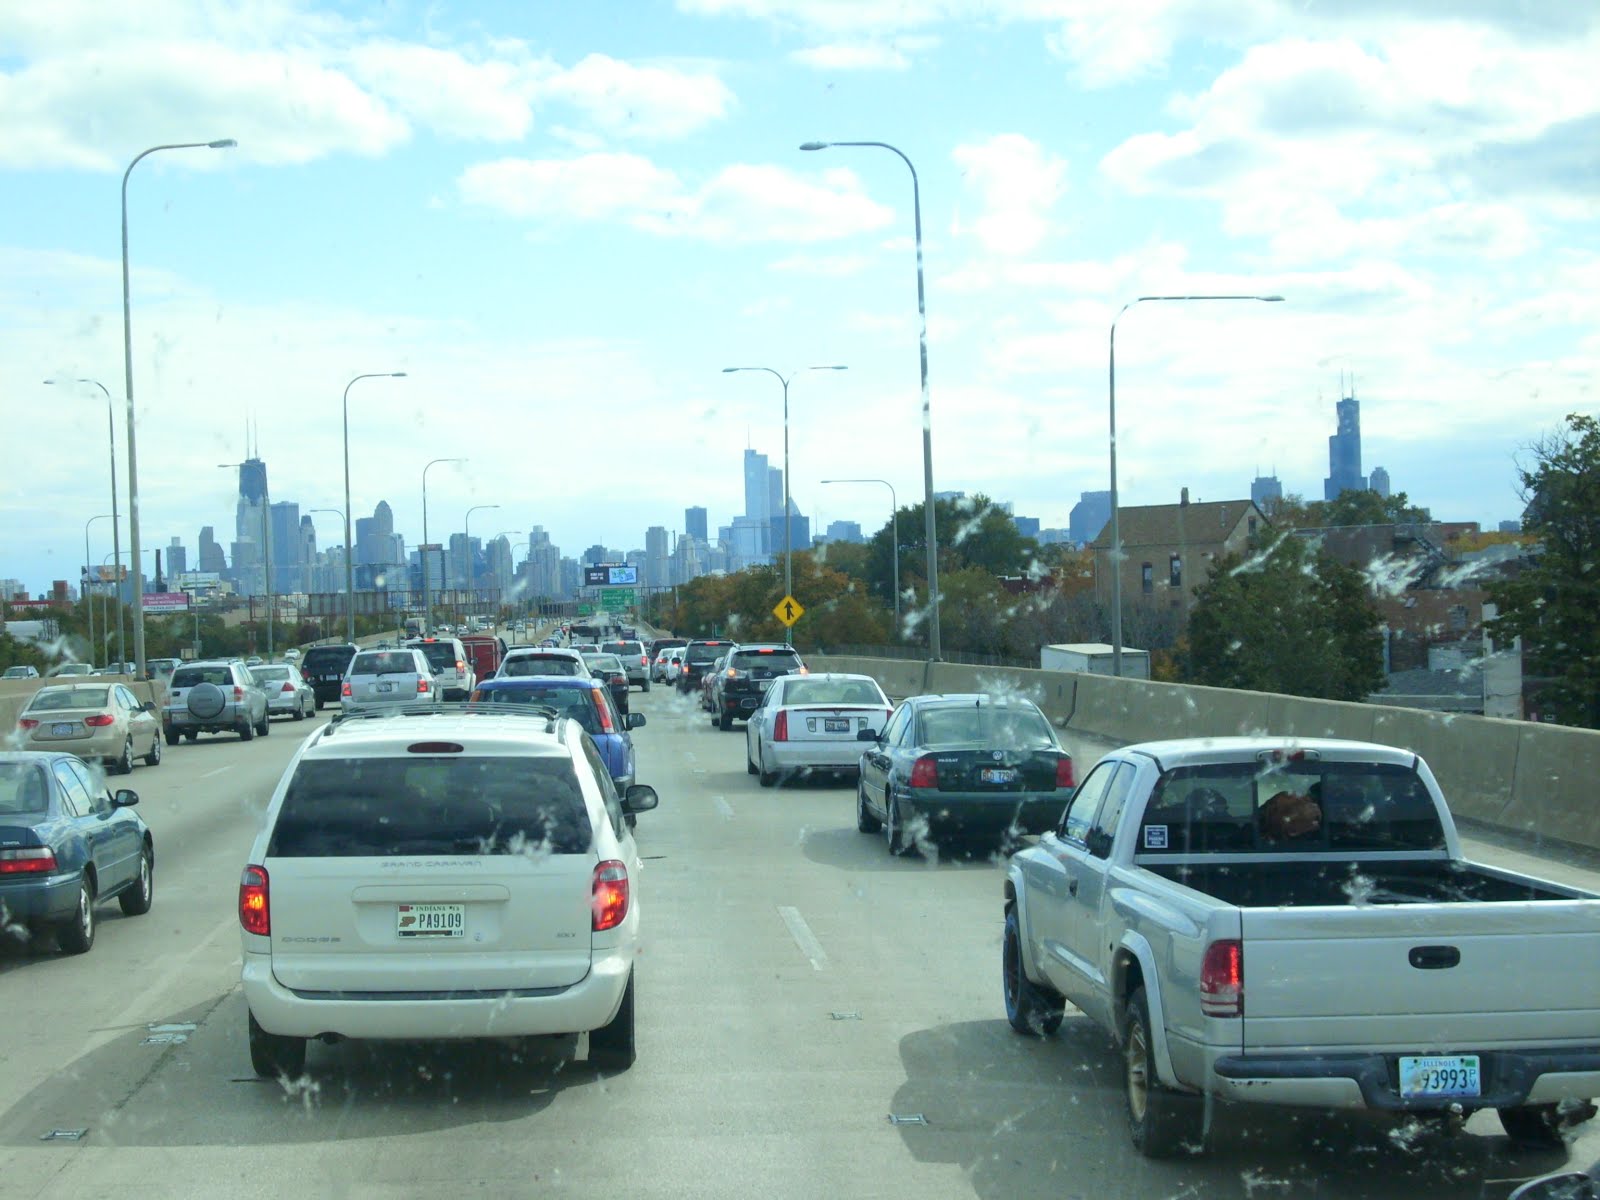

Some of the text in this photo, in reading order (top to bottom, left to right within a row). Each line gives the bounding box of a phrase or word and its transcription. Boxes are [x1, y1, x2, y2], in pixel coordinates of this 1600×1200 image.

[419, 913, 462, 929] PA9109
[281, 936, 341, 944] DODGE
[1421, 1069, 1467, 1089] 93993
